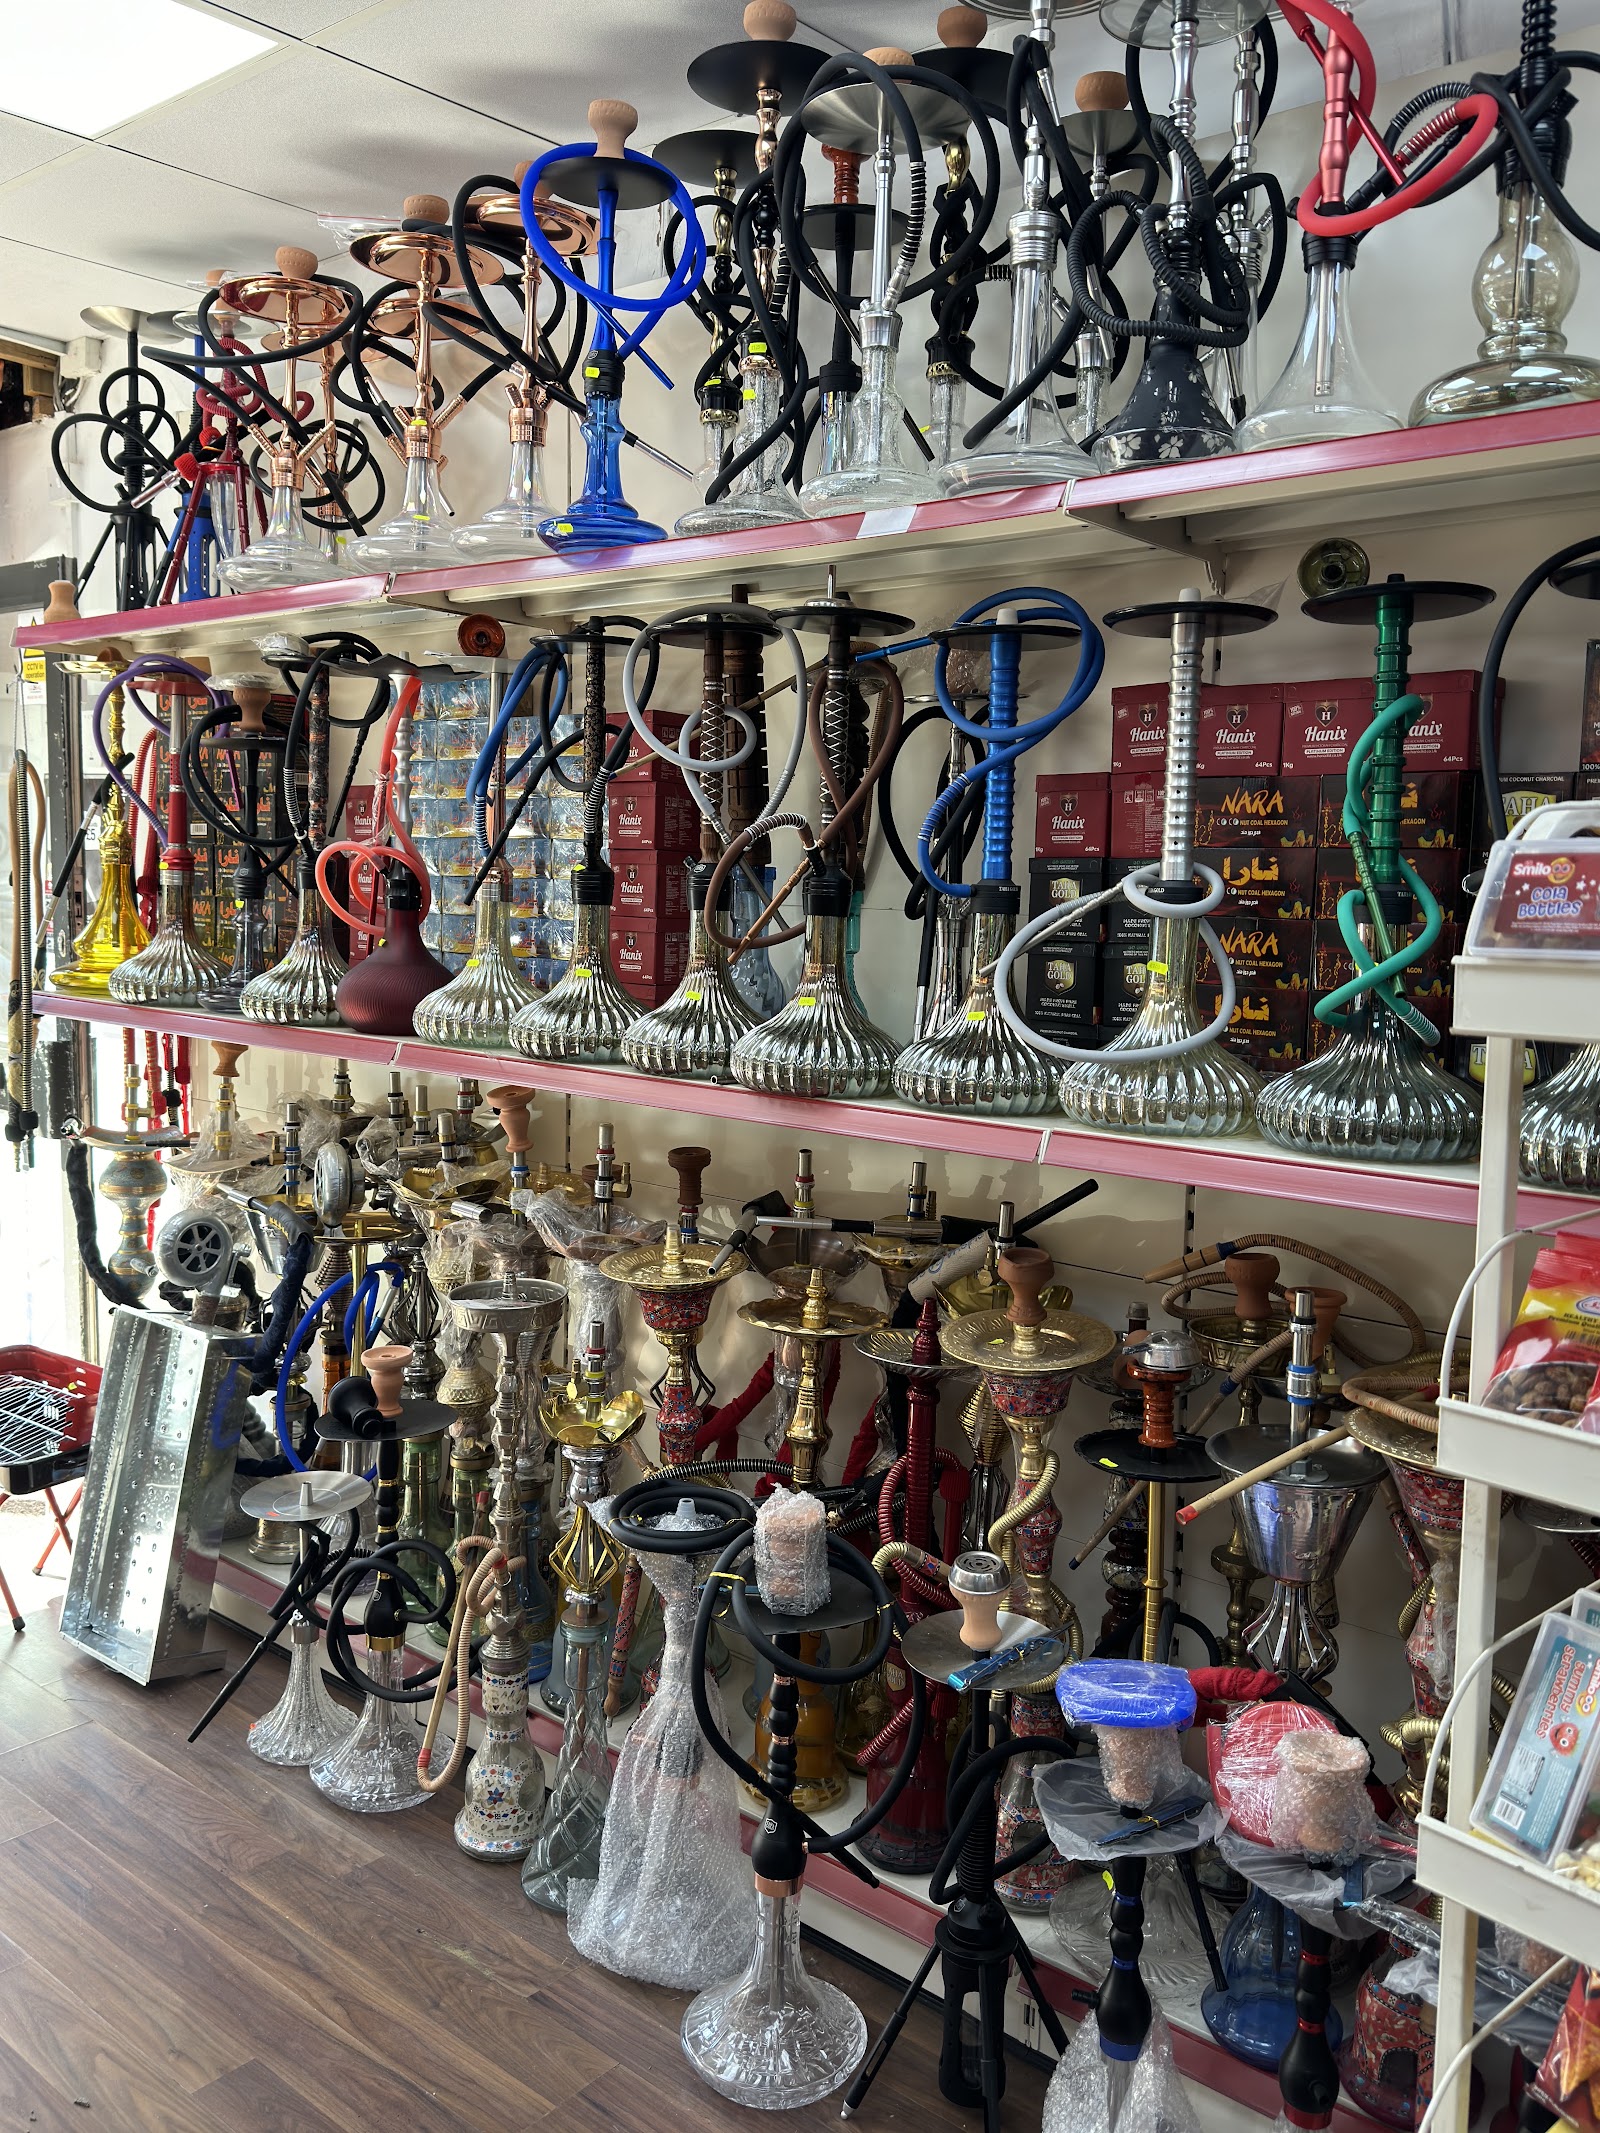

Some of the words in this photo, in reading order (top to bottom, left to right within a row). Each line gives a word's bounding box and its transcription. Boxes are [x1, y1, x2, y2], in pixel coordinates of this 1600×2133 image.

[1144, 713, 1152, 722] H
[1232, 715, 1241, 724] H
[1321, 711, 1331, 720] H
[1130, 726, 1166, 742] Hanix
[1305, 726, 1348, 742] Hanix
[1409, 720, 1443, 737] anix
[1216, 729, 1256, 744] Hanix
[1220, 786, 1284, 816] NARA
[619, 814, 642, 826] Hanix
[1051, 815, 1086, 829] Hanix
[1222, 856, 1279, 886] نارا
[1513, 861, 1551, 876] Smilo
[620, 882, 644, 894] Hanix
[1051, 881, 1077, 890] TAHA
[1051, 889, 1077, 899] GOLD
[1219, 926, 1279, 957] NARA
[619, 949, 643, 961] Hanix
[1047, 962, 1071, 971] TAHA
[1126, 966, 1146, 975] TAH
[1047, 970, 1073, 980] GOLD
[1126, 974, 1146, 984] GOL
[1252, 1029, 1276, 1037] HEXAGON
[1536, 1644, 1576, 1740] strawberries
